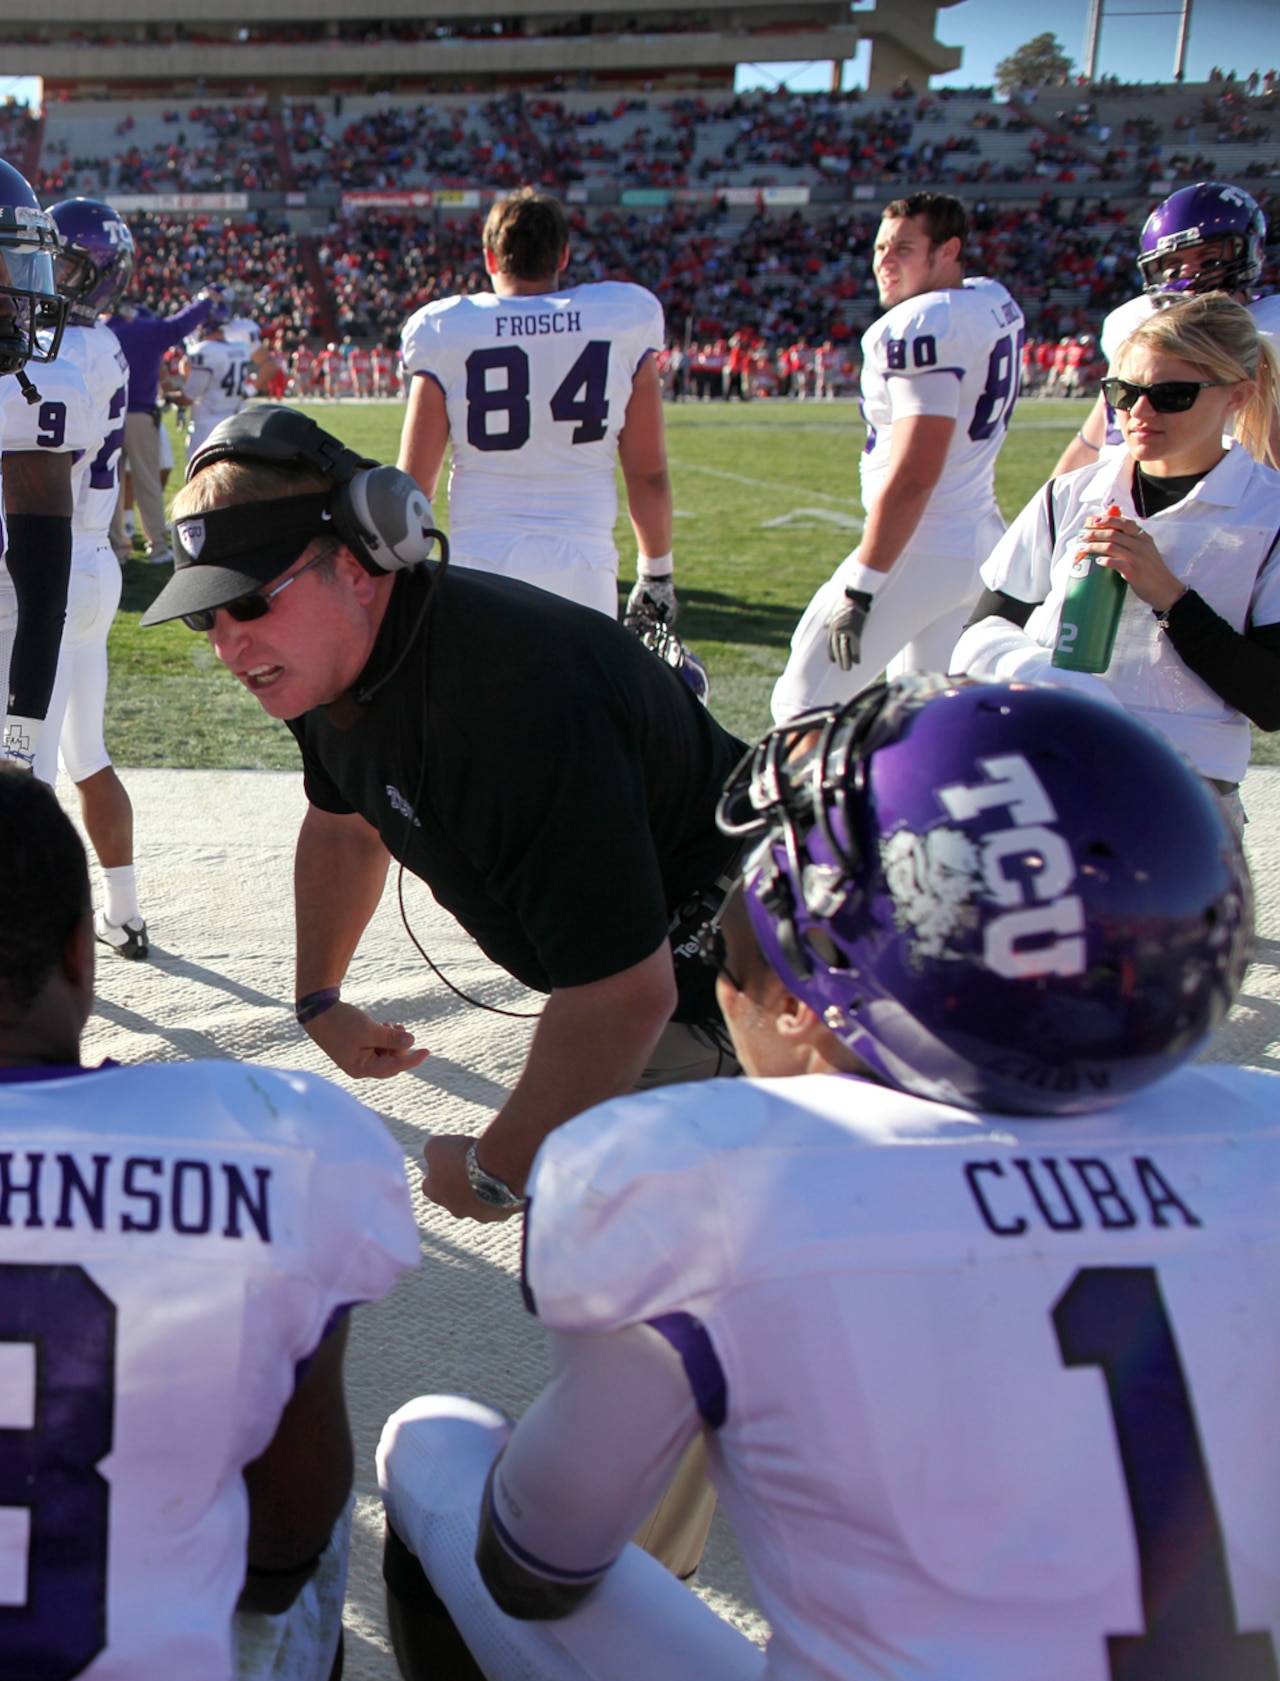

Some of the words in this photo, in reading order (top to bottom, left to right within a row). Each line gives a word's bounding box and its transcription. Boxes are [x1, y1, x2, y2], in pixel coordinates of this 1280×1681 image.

[495, 311, 582, 337] FROSCH
[887, 334, 937, 370] 80
[36, 401, 66, 448] 9
[465, 340, 612, 452] 84
[937, 753, 1087, 980] TCU
[963, 1156, 1204, 1237] CUBA
[1049, 1266, 1280, 1681] 1
